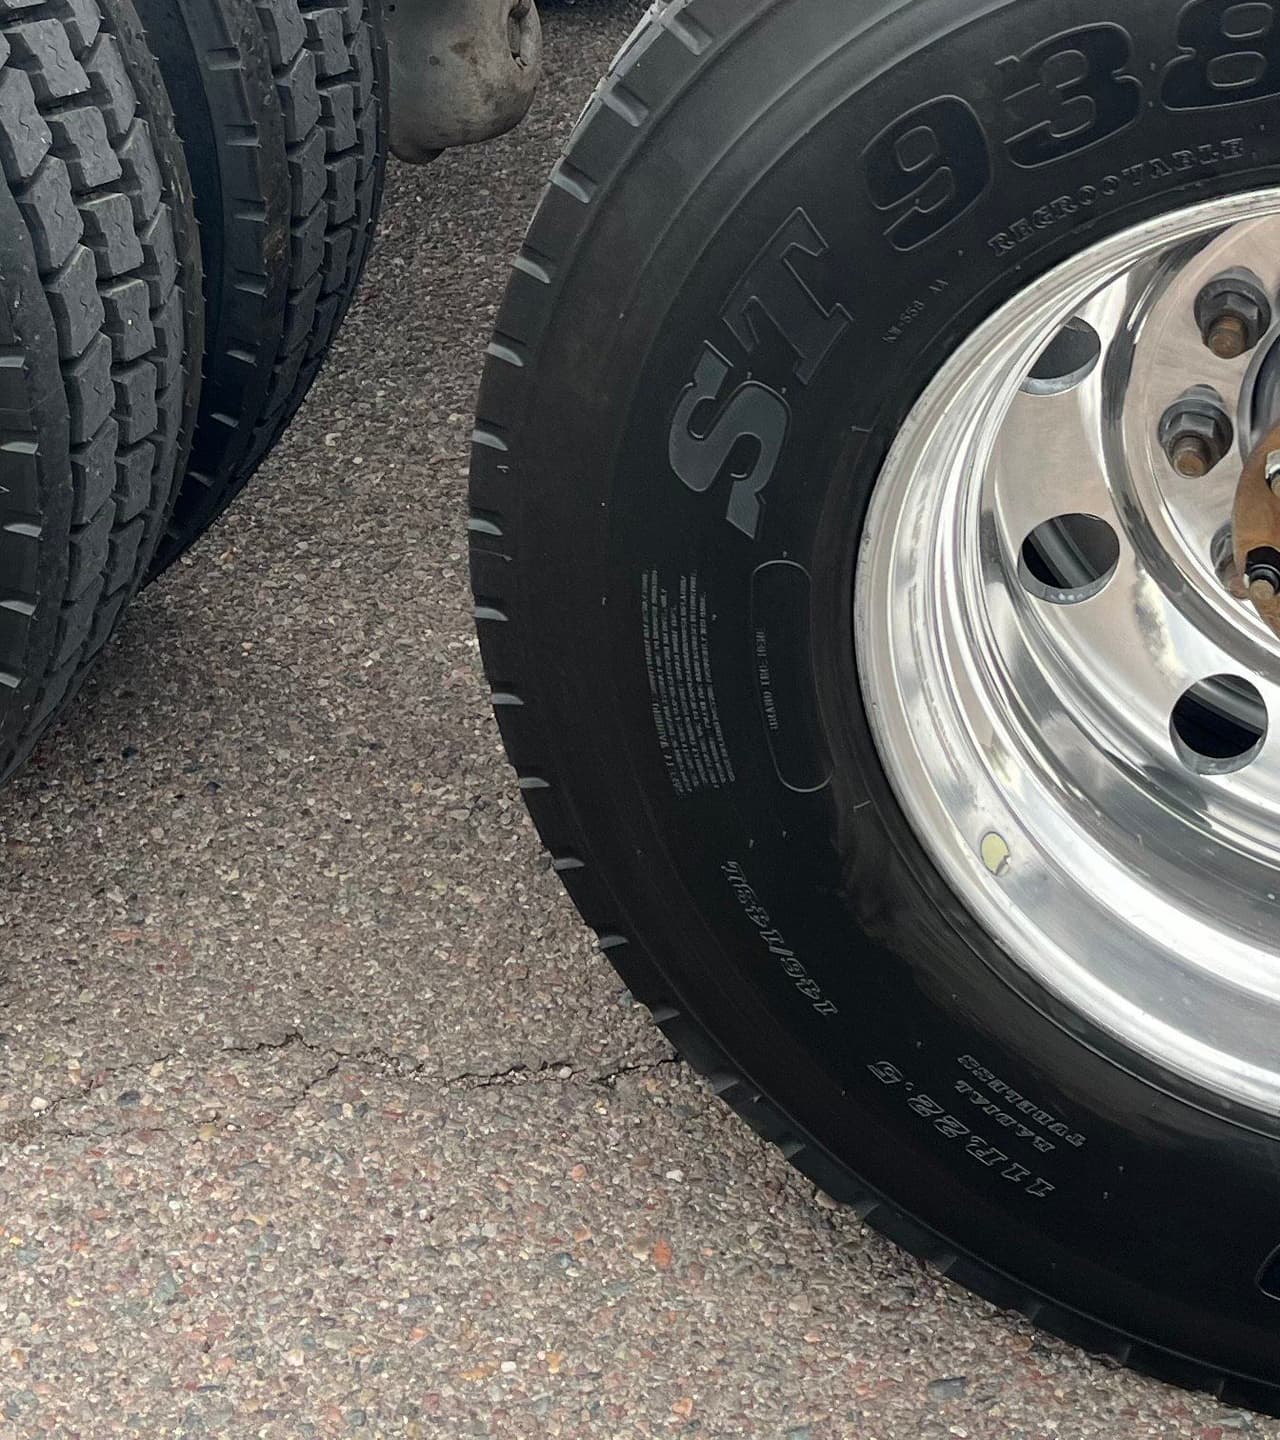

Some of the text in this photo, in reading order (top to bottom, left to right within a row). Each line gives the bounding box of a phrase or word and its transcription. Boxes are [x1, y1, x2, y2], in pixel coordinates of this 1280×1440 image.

[986, 137, 1245, 257] REGROOVABLE
[668, 206, 855, 540] ST
[867, 1060, 1057, 1200] 11R22.5
